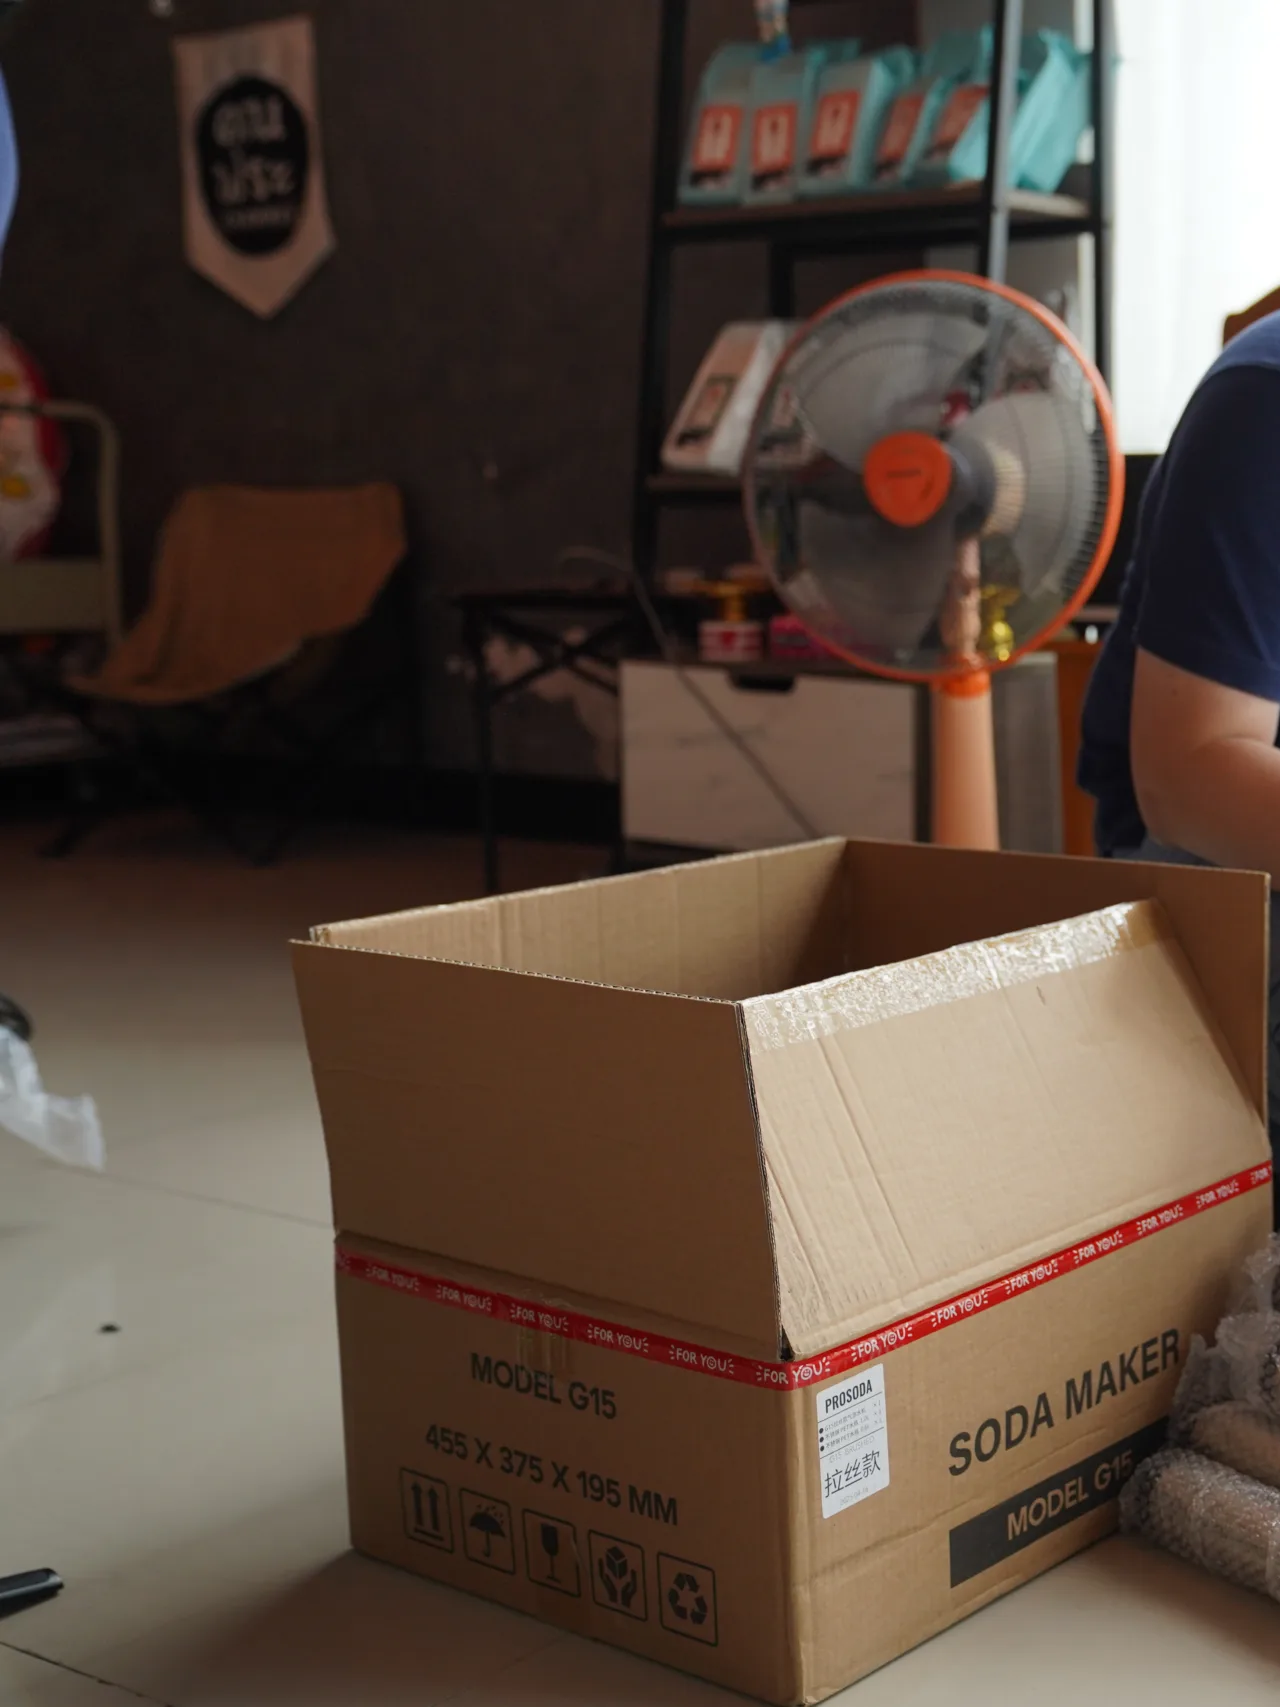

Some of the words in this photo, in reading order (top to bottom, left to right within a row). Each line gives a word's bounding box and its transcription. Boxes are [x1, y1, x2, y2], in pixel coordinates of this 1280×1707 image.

[1141, 1215, 1159, 1232] FOR
[1078, 1243, 1096, 1260] FOR
[1096, 1234, 1118, 1252] YOU
[1010, 1273, 1030, 1291] FOR
[1031, 1262, 1053, 1282] YOU
[442, 1286, 461, 1302] FOR
[463, 1293, 486, 1310] YOU
[937, 1304, 957, 1323] FOR
[958, 1293, 982, 1314] YOU
[516, 1306, 535, 1322] FOR
[538, 1312, 563, 1329] YOU
[594, 1327, 614, 1343] FOR
[616, 1333, 642, 1350] YOU
[857, 1338, 879, 1358] FOR
[880, 1326, 906, 1348] YOU
[676, 1348, 697, 1365] FOR
[700, 1355, 727, 1372] YOU
[764, 1369, 788, 1385] FOR
[792, 1361, 822, 1382] YOU
[470, 1353, 562, 1404] MODEL
[569, 1382, 617, 1420] G15
[825, 1379, 873, 1414] PROSODA
[948, 1391, 1054, 1477] SODA
[1065, 1328, 1180, 1420] MAKER
[426, 1424, 468, 1460] 455
[474, 1437, 494, 1469] X
[500, 1446, 544, 1484] 375
[552, 1461, 571, 1493] X
[577, 1470, 622, 1508] 195
[628, 1484, 678, 1526] MM
[825, 1450, 881, 1498] 拉丝款
[1007, 1475, 1089, 1541] MODEL
[1094, 1449, 1134, 1490] G15
